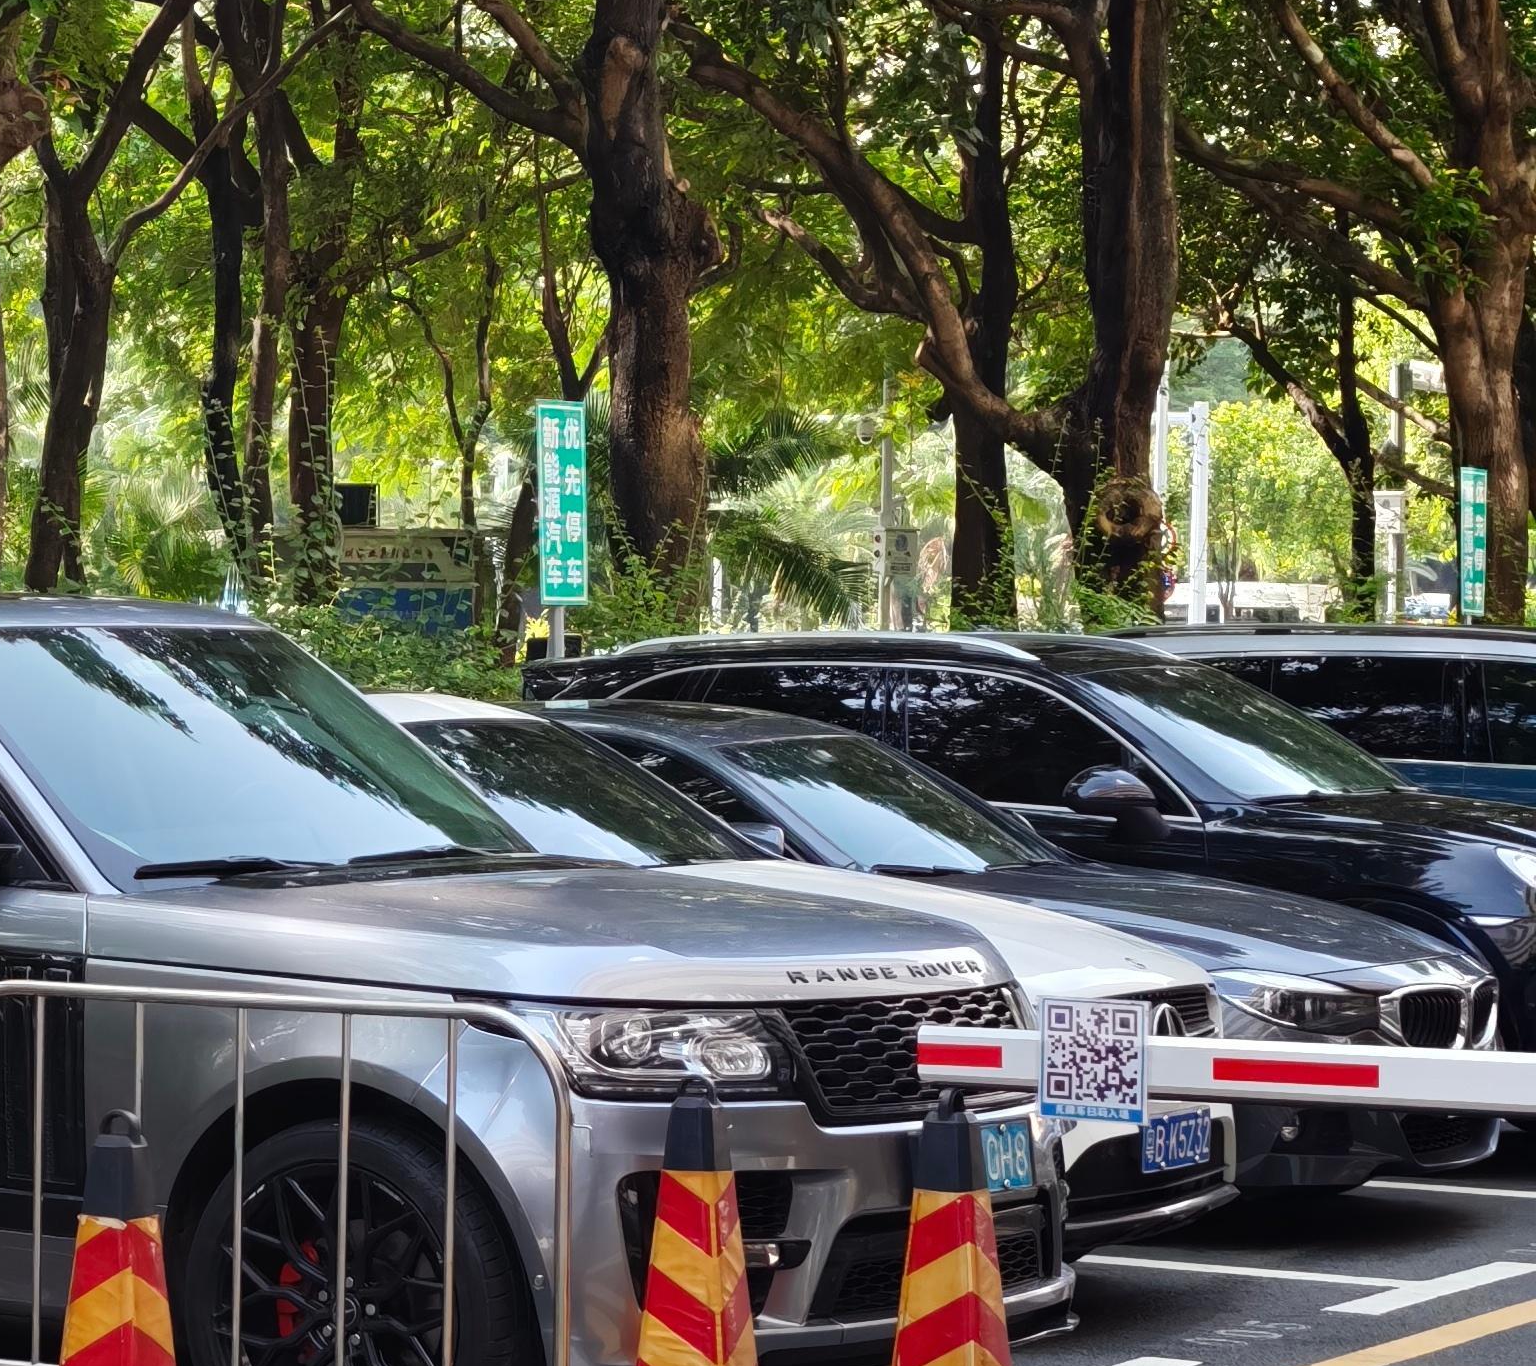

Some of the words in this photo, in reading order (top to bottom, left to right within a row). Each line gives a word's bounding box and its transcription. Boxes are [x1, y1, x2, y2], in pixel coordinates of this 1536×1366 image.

[543, 416, 564, 590] 新能源汽车
[564, 417, 583, 589] 优先停车
[786, 965, 898, 985] RANGE
[906, 959, 982, 978] ROVER
